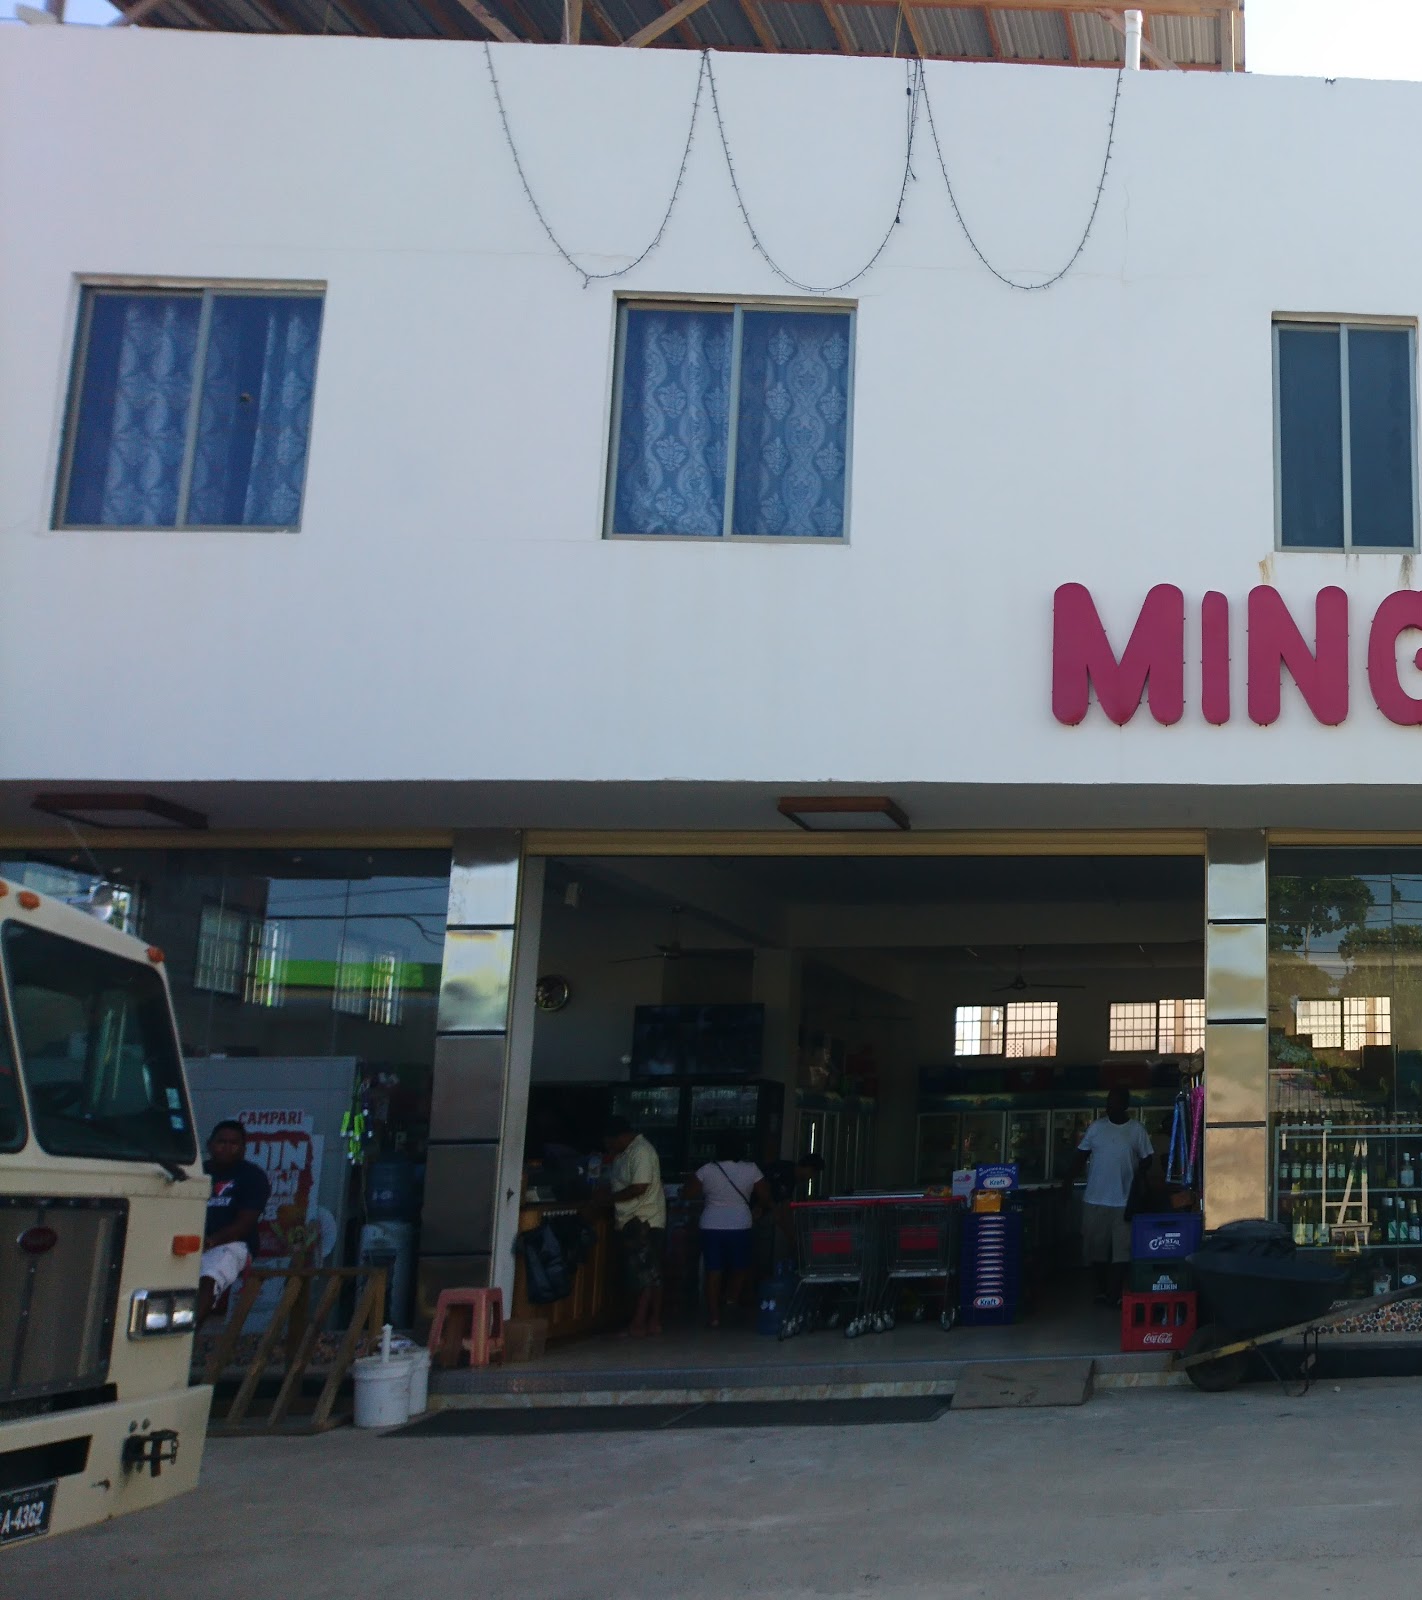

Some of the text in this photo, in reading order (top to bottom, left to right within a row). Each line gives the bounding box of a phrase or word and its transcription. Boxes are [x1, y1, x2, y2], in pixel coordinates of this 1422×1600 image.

[238, 1110, 303, 1125] CAMPARI
[989, 1178, 1006, 1186] Kraft
[1152, 1283, 1178, 1291] BELIKIN
